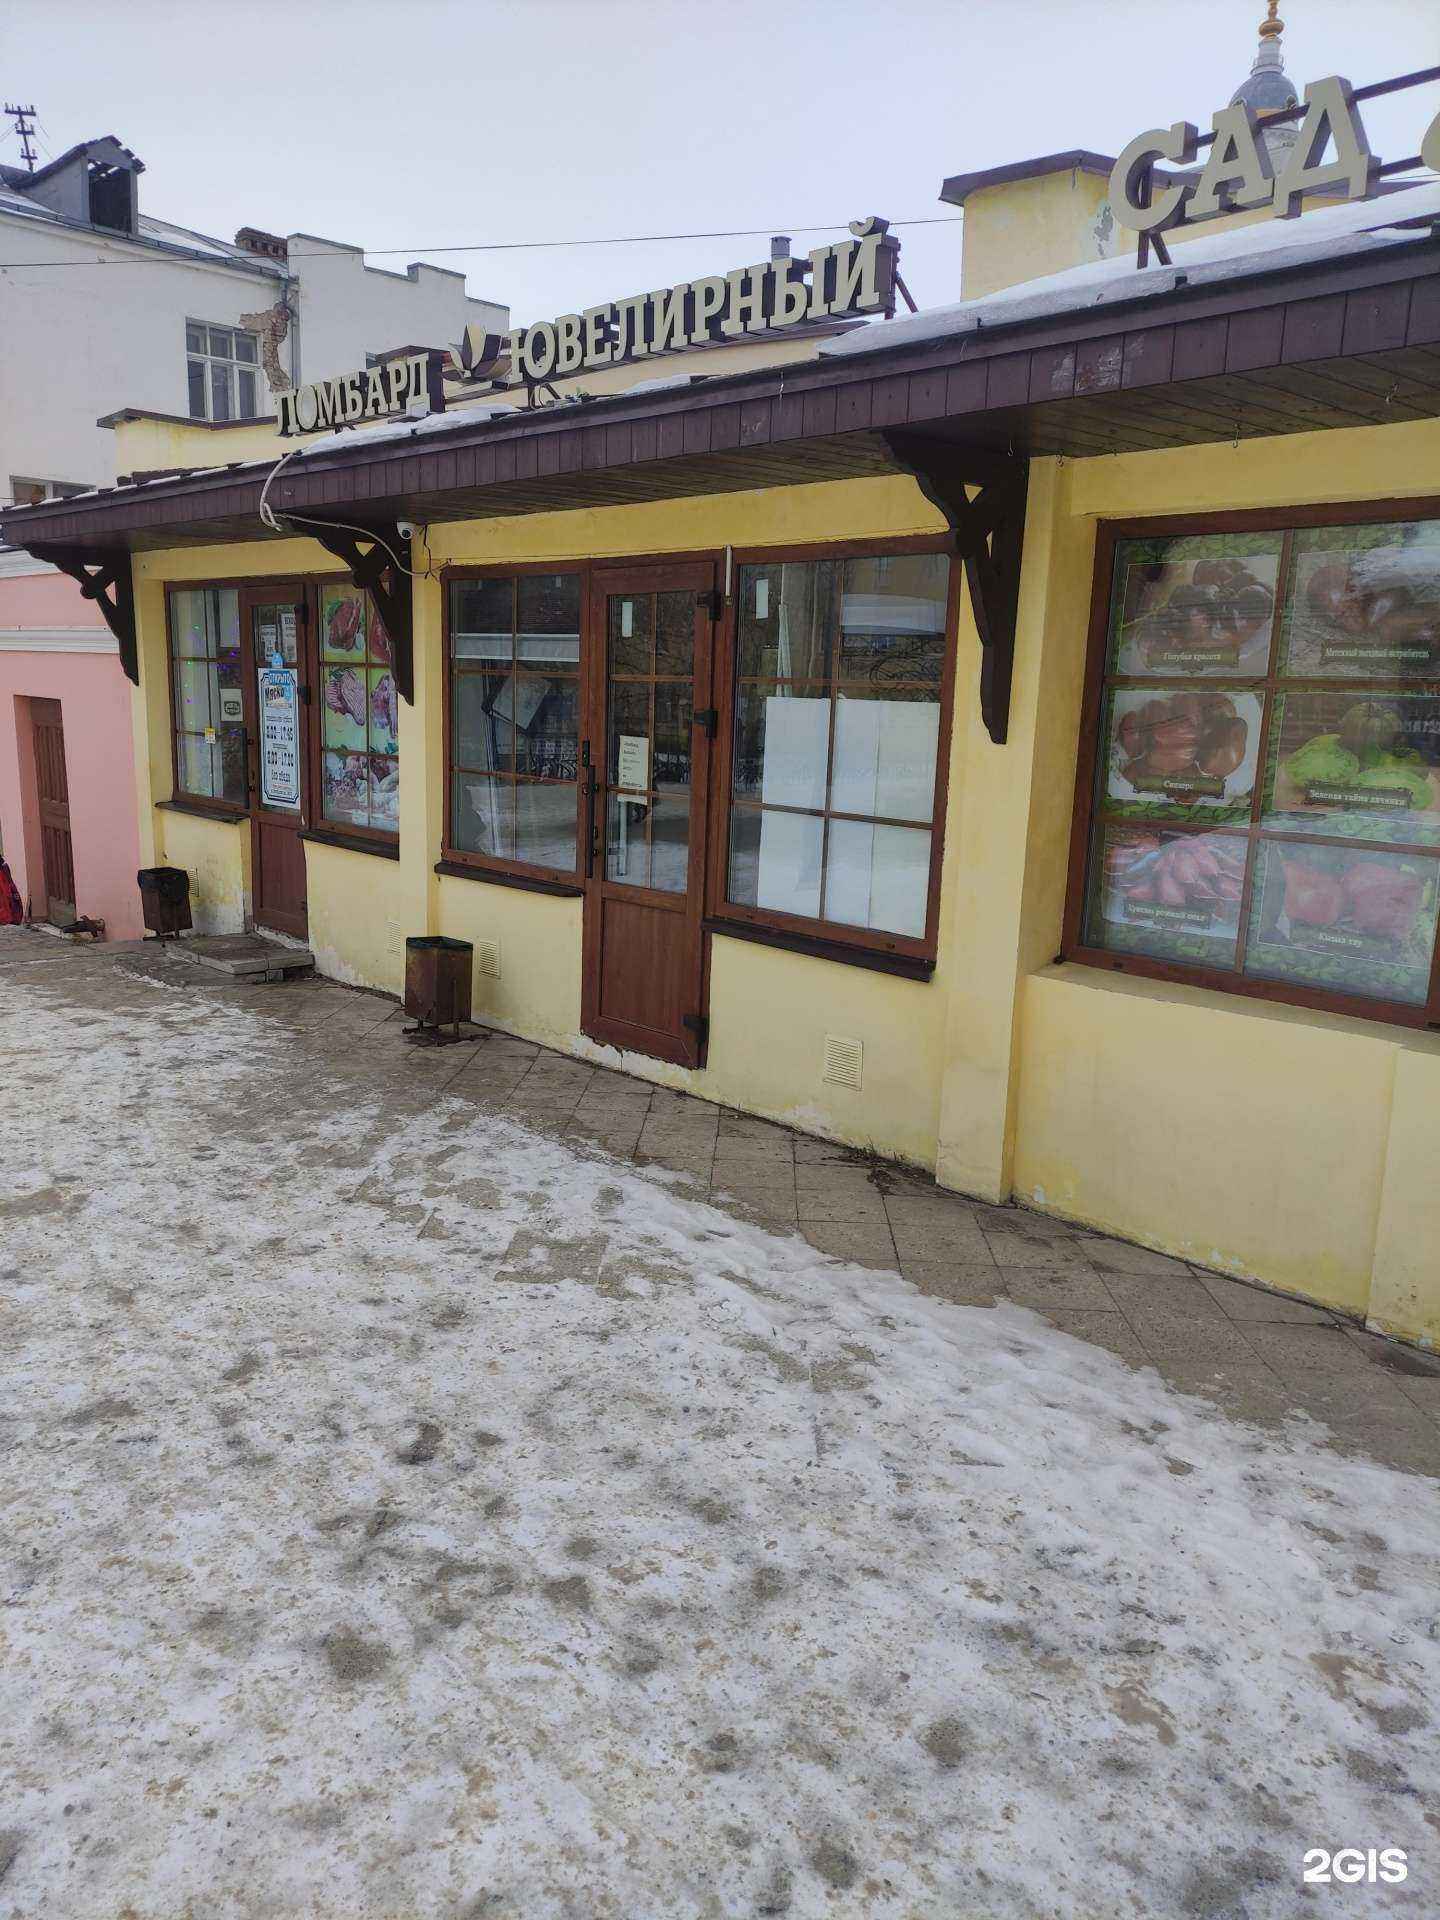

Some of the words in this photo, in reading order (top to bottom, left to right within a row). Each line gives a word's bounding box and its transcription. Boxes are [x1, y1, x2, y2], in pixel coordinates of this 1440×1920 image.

[1109, 76, 1376, 231] САД
[506, 216, 888, 385] ЮВЕЛИРНЫЙ
[272, 352, 431, 437] ЛОМБАРД
